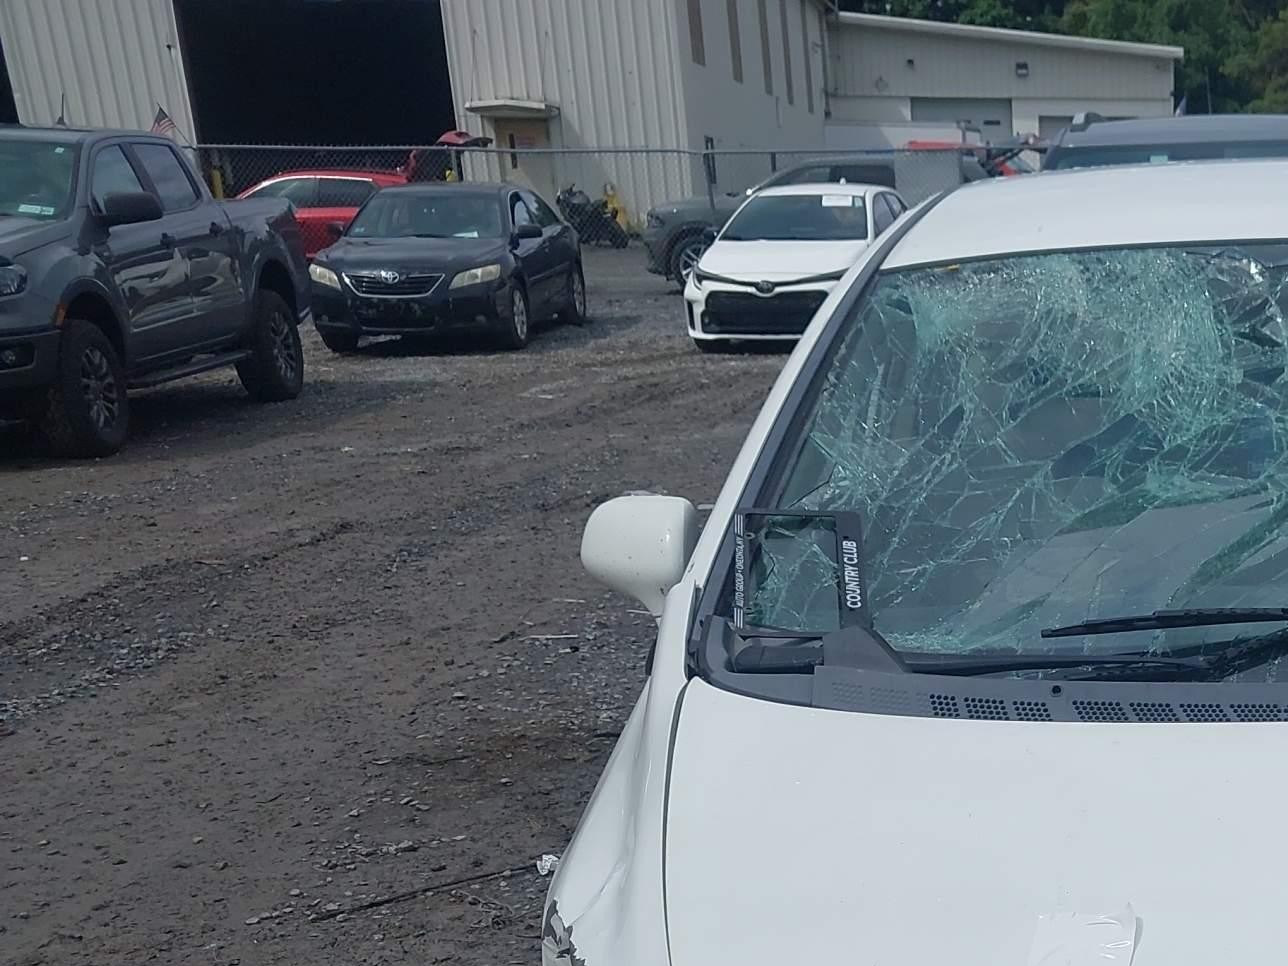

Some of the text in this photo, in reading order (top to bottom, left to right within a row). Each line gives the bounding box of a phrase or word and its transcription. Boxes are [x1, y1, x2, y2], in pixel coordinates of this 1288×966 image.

[735, 573, 744, 592] GROUP
[842, 541, 862, 608] COUNTRY CLUB
[735, 592, 744, 608] AUTO
